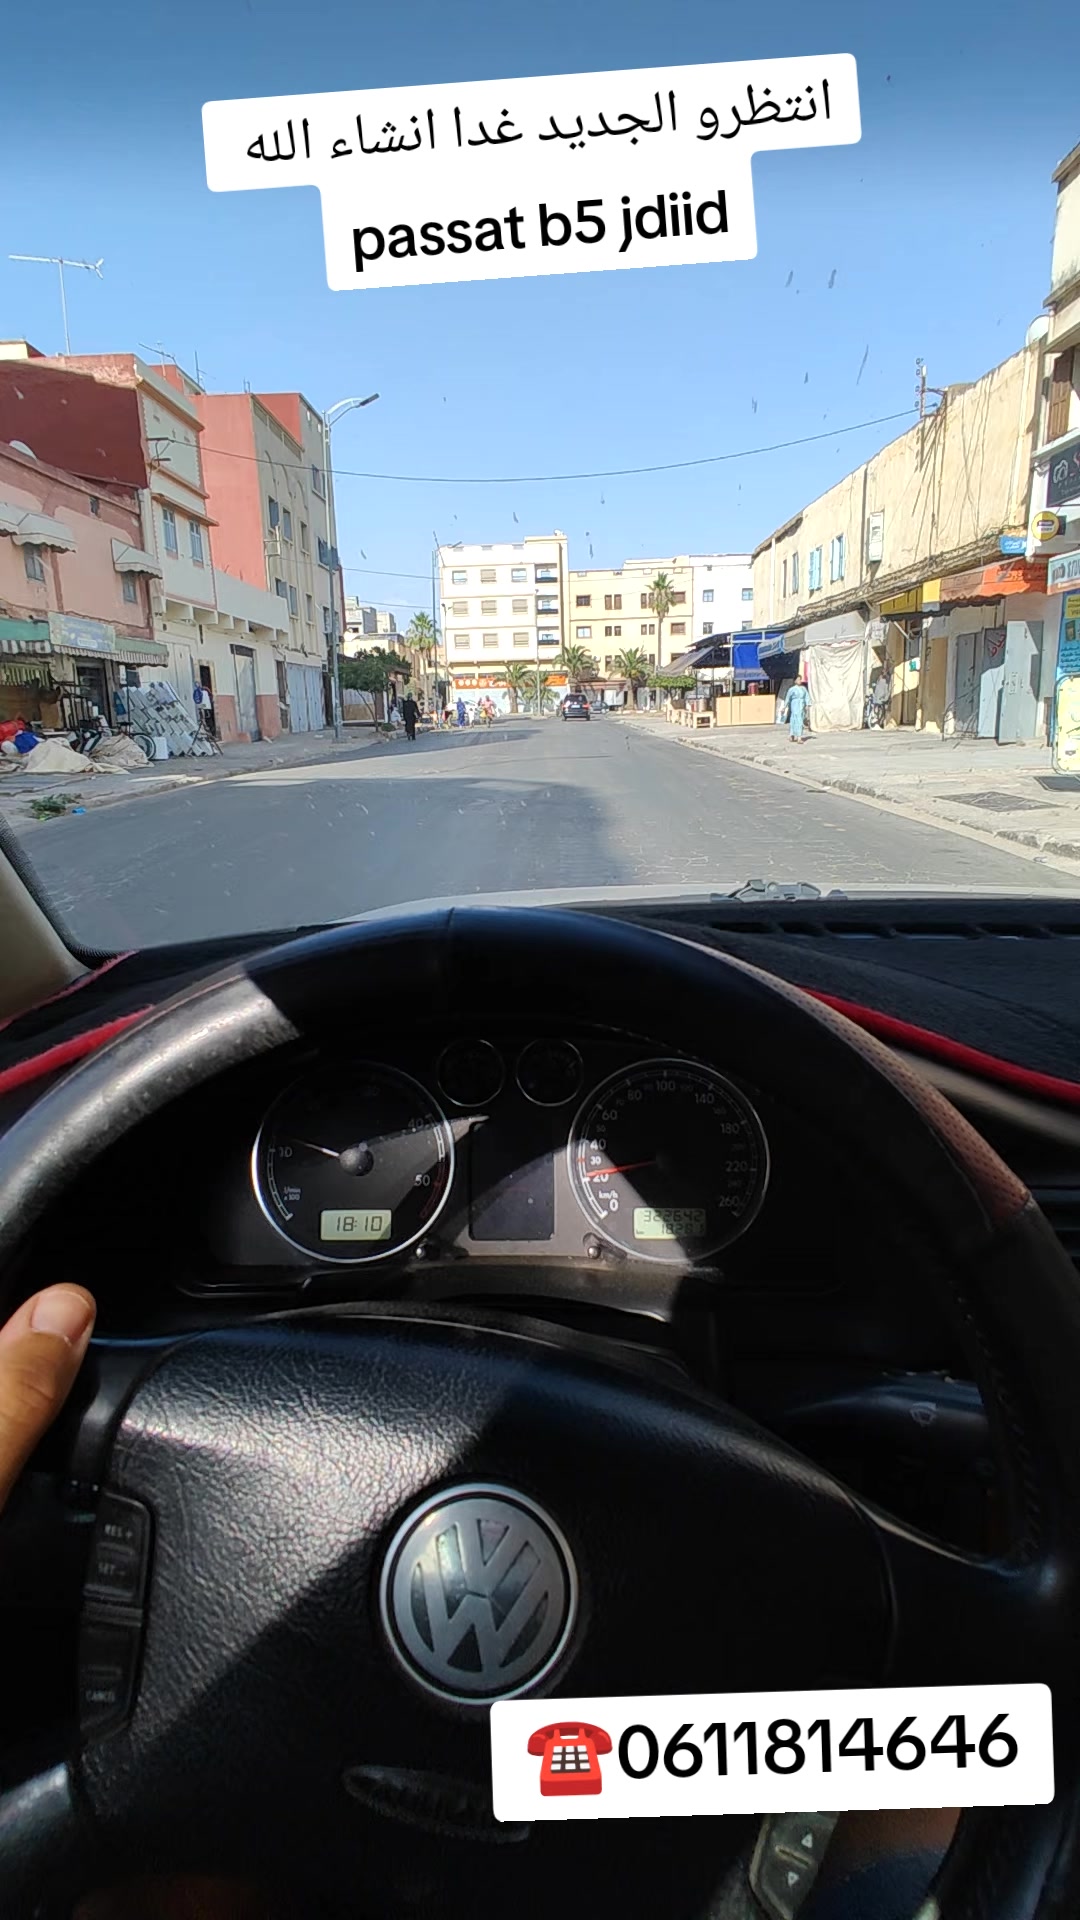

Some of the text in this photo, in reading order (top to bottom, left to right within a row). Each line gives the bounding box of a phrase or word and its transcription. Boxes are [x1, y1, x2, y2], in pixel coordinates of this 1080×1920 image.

[655, 1081, 675, 1091] 100
[627, 1090, 642, 1101] 80
[695, 1093, 715, 1104] 140
[602, 1109, 618, 1121] 60
[720, 1123, 740, 1134] 180
[589, 1139, 607, 1150] 40
[278, 1146, 293, 1158] 10
[590, 1156, 602, 1165] 30
[725, 1161, 748, 1172] 220
[414, 1174, 431, 1187] 50
[592, 1171, 609, 1183] 20
[599, 1190, 619, 1199] km/h
[609, 1200, 619, 1211] 0
[719, 1196, 740, 1207] 260
[336, 1216, 383, 1232] 18:10
